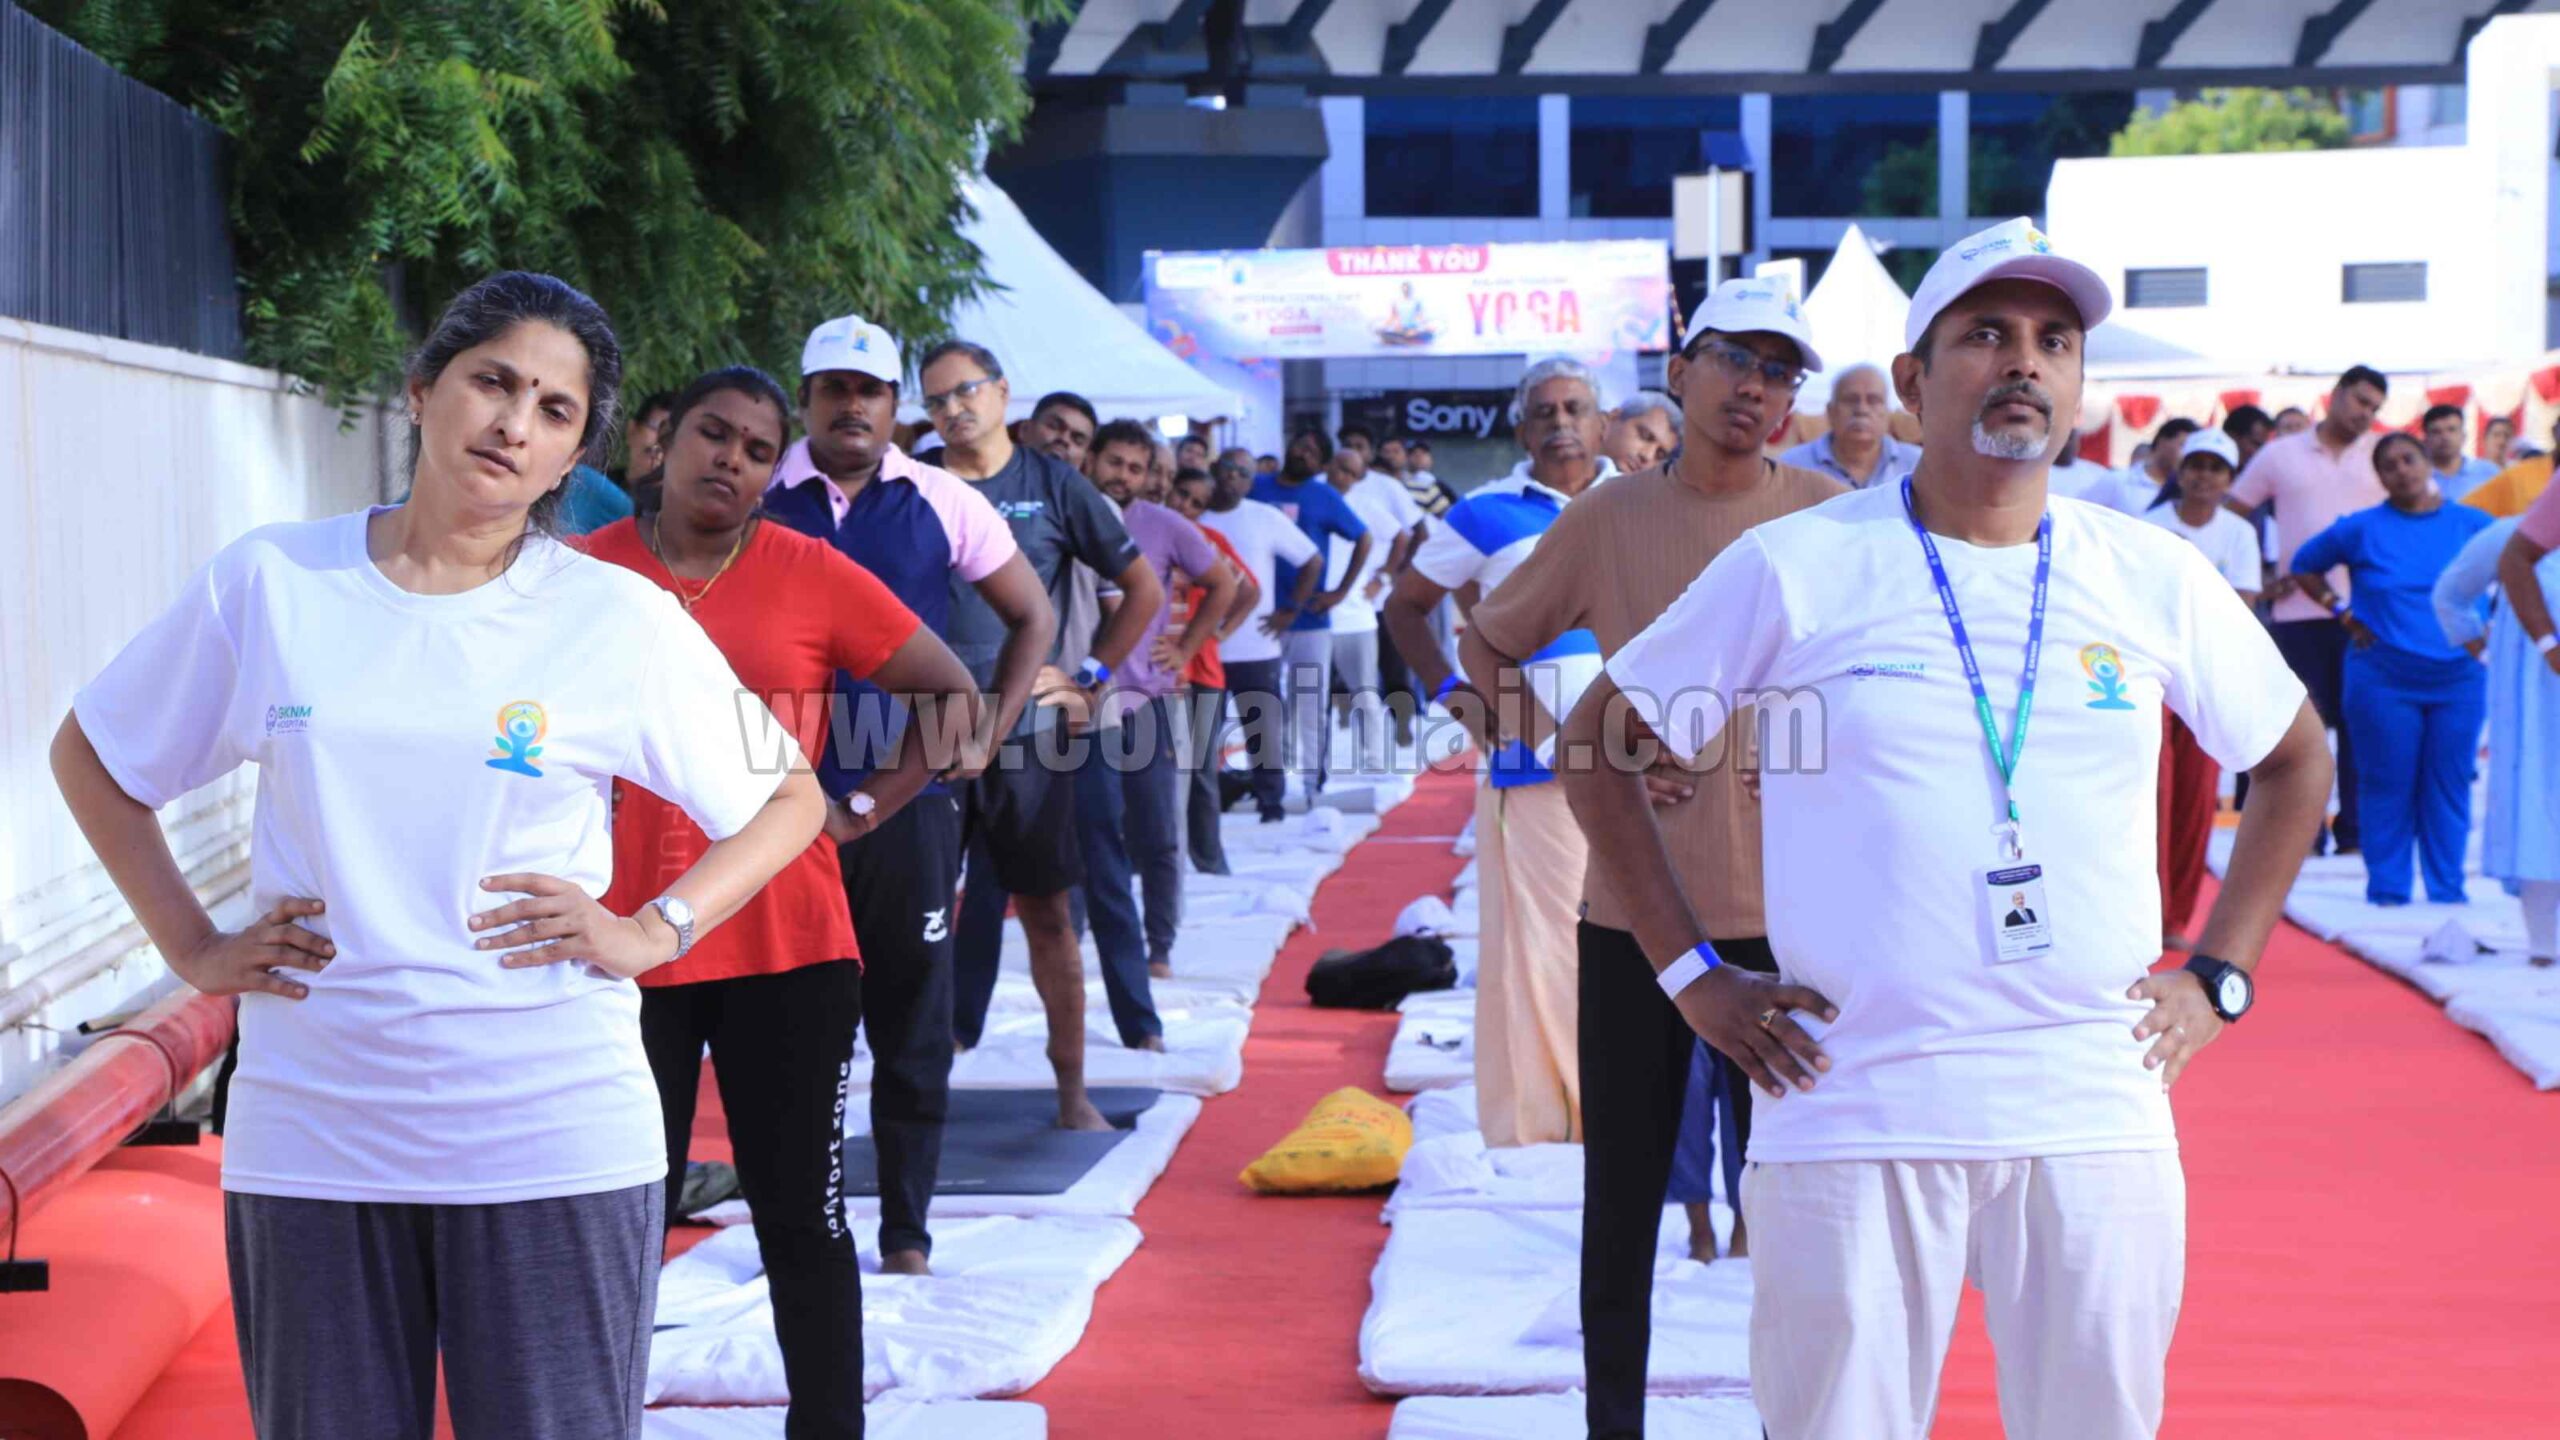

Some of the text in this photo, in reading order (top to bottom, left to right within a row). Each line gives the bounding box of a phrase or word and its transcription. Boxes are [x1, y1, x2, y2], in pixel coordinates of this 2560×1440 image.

[1340, 249, 1481, 273] THANK YOU
[1466, 290, 1581, 336] YOGA
[1407, 398, 1497, 439] Sony
[278, 705, 312, 719] GKNM
[833, 1062, 848, 1130] zone
